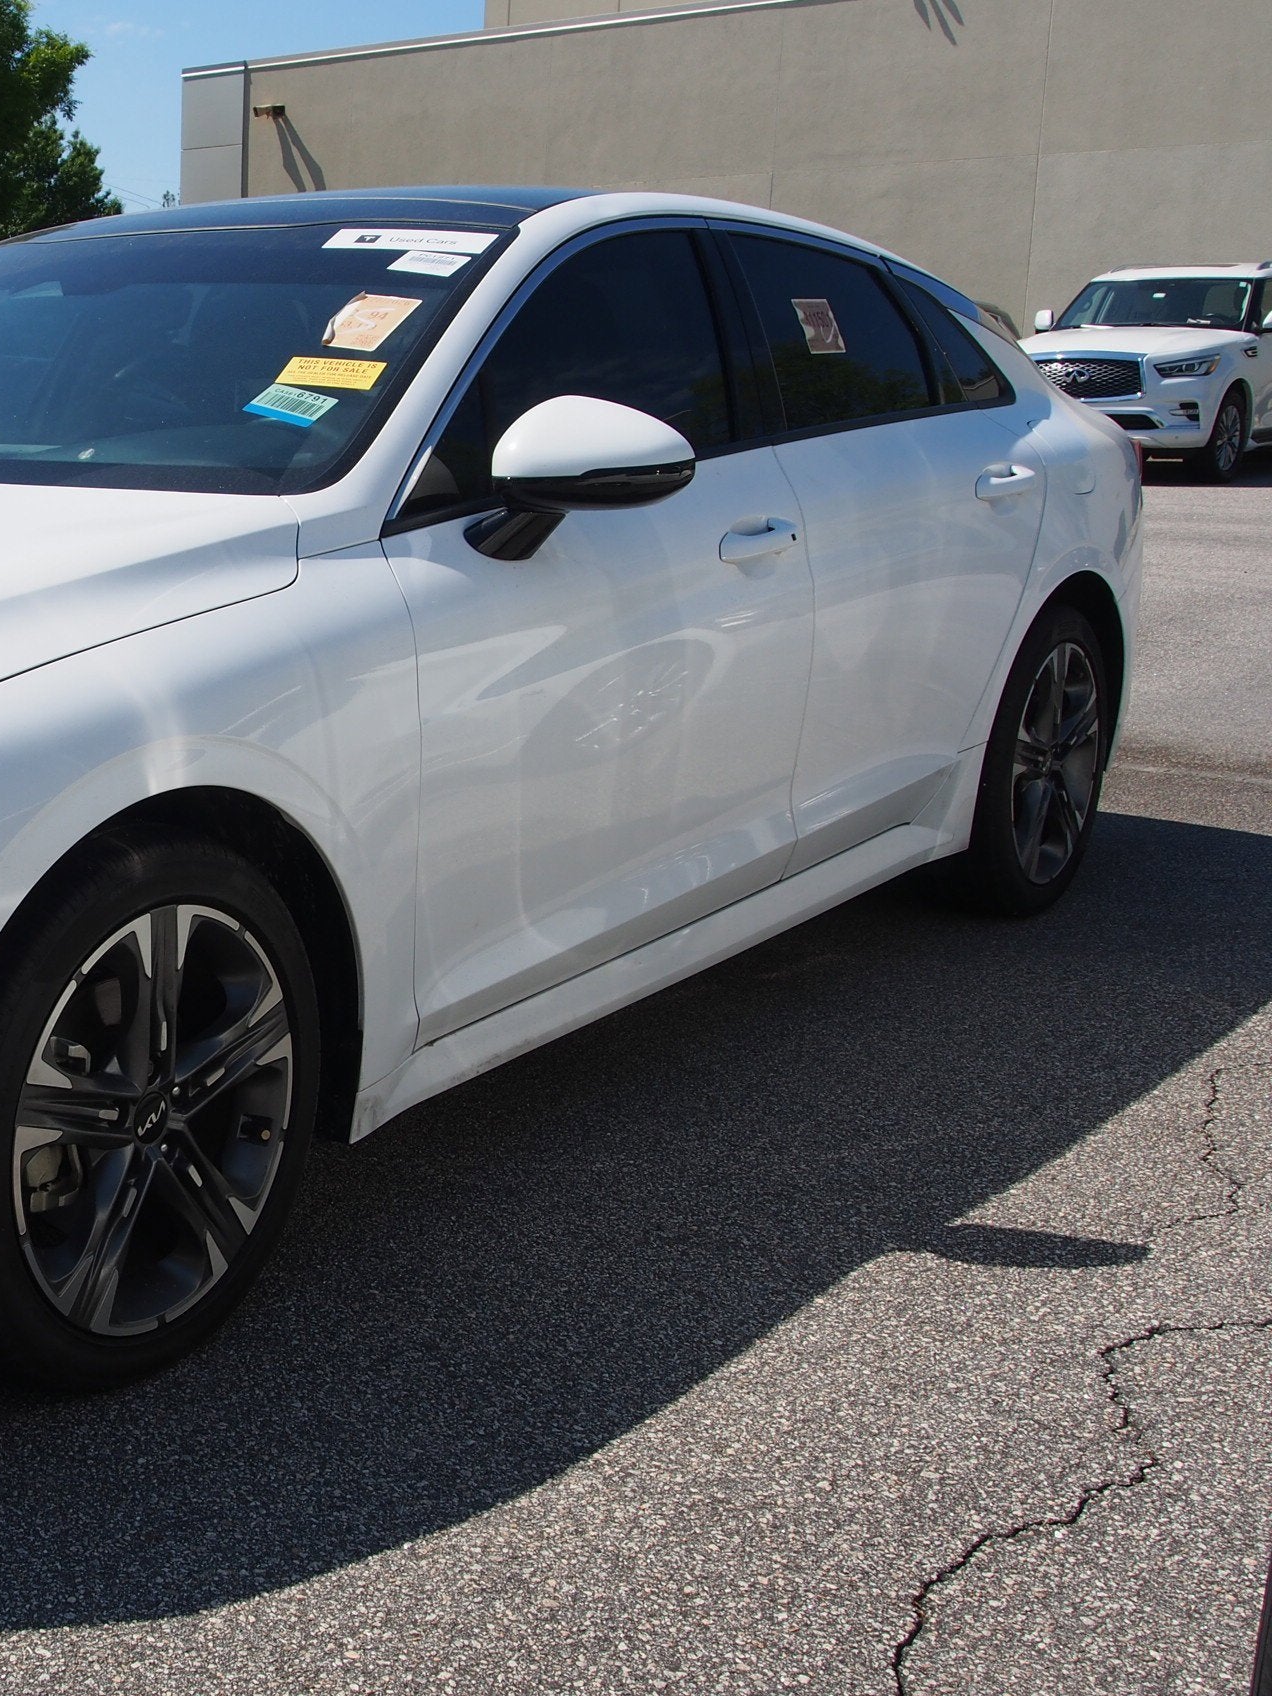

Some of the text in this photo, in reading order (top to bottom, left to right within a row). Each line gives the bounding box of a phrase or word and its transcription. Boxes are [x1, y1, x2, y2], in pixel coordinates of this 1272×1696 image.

[389, 235, 424, 245] Used
[426, 237, 459, 246] Cars
[323, 360, 365, 368] VEHICLE
